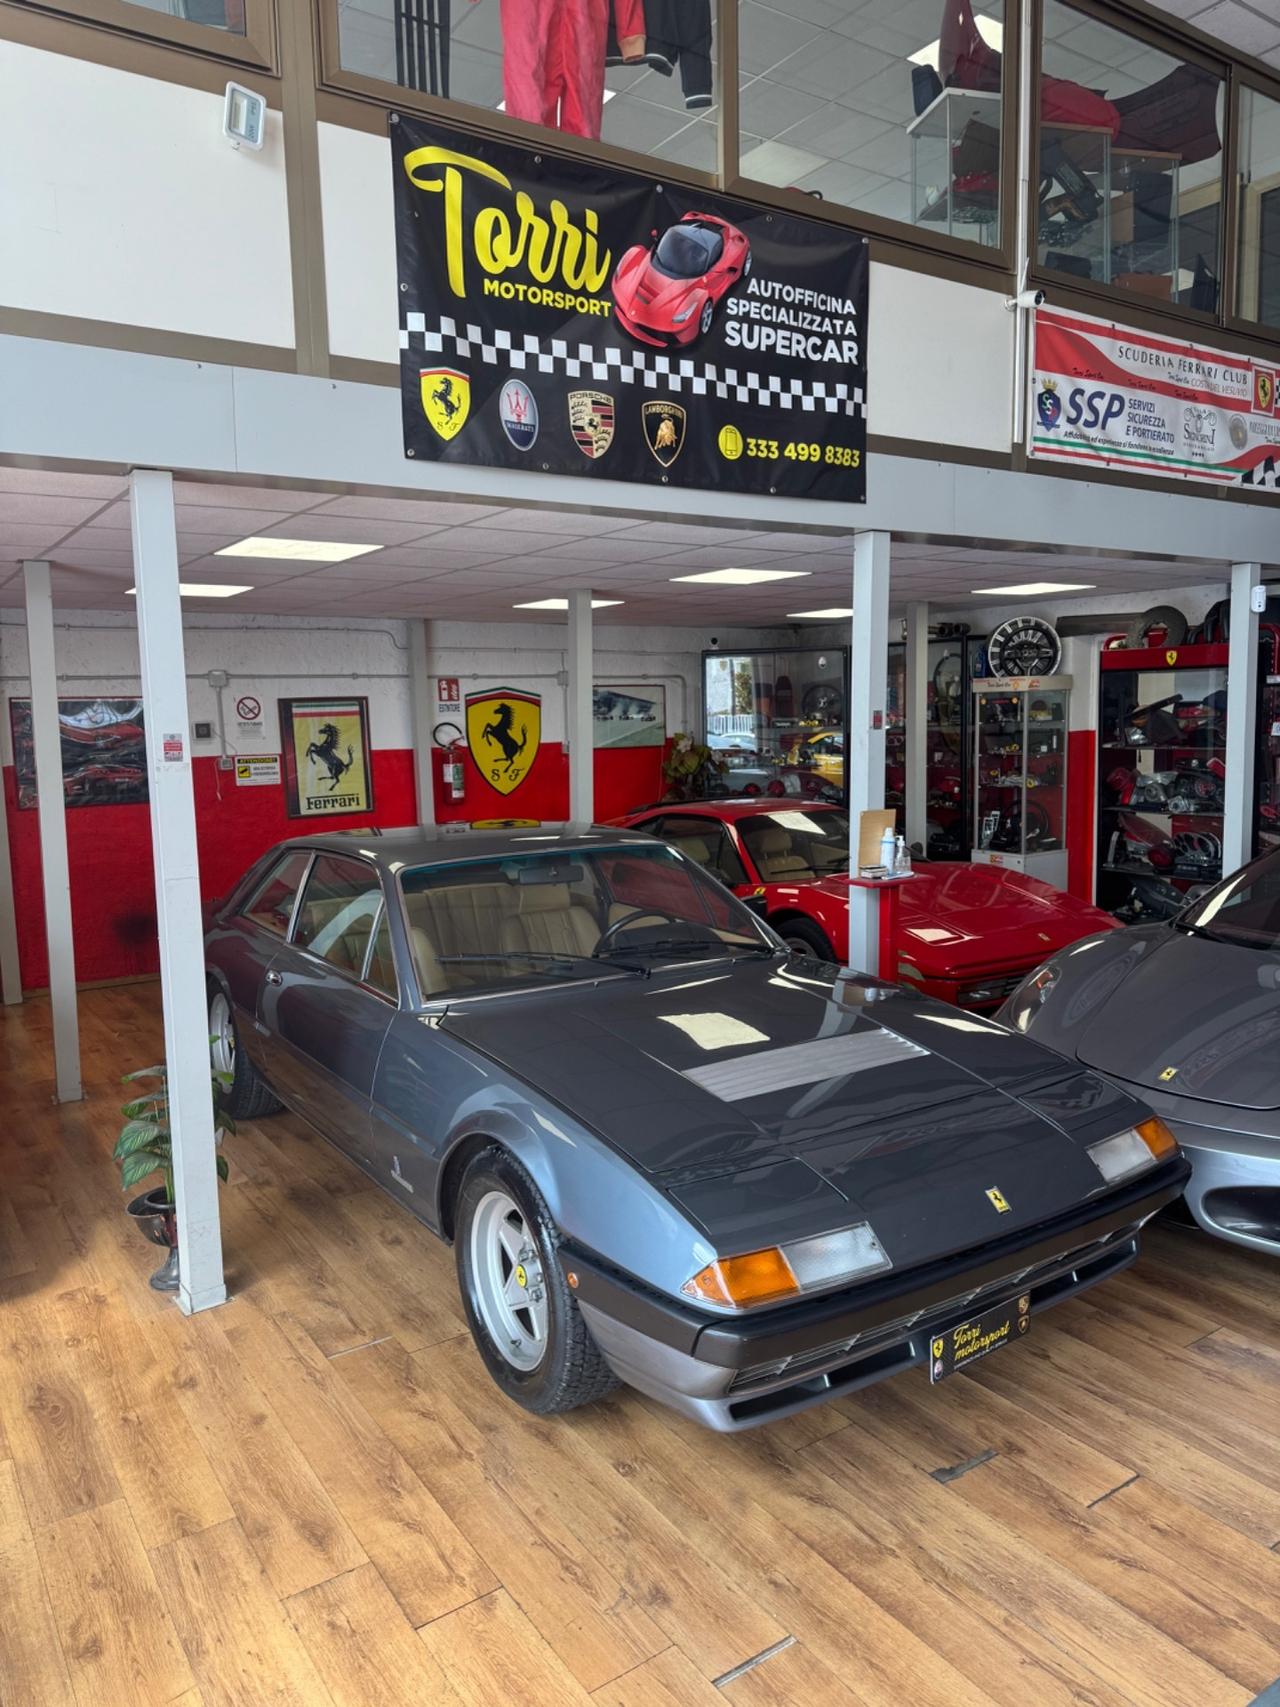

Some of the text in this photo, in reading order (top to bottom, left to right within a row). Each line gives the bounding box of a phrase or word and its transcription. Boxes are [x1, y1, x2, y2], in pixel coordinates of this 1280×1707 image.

[404, 145, 611, 298] Torri
[483, 278, 611, 317] MOTORSPORT
[747, 278, 857, 315] AUTOFFICINA
[726, 297, 857, 336] SPECIALIZZATA
[725, 320, 859, 365] SUPERCAR
[1118, 345, 1248, 386] SCUDERIA FERRARI CLUB
[1066, 387, 1126, 431] SSP
[1127, 412, 1167, 429] SICUREZZA
[1128, 398, 1156, 414] SERVIZI
[746, 438, 860, 468] 333 499 8383
[1126, 425, 1175, 444] E PORTIERATO
[306, 793, 360, 810] Ferrari
